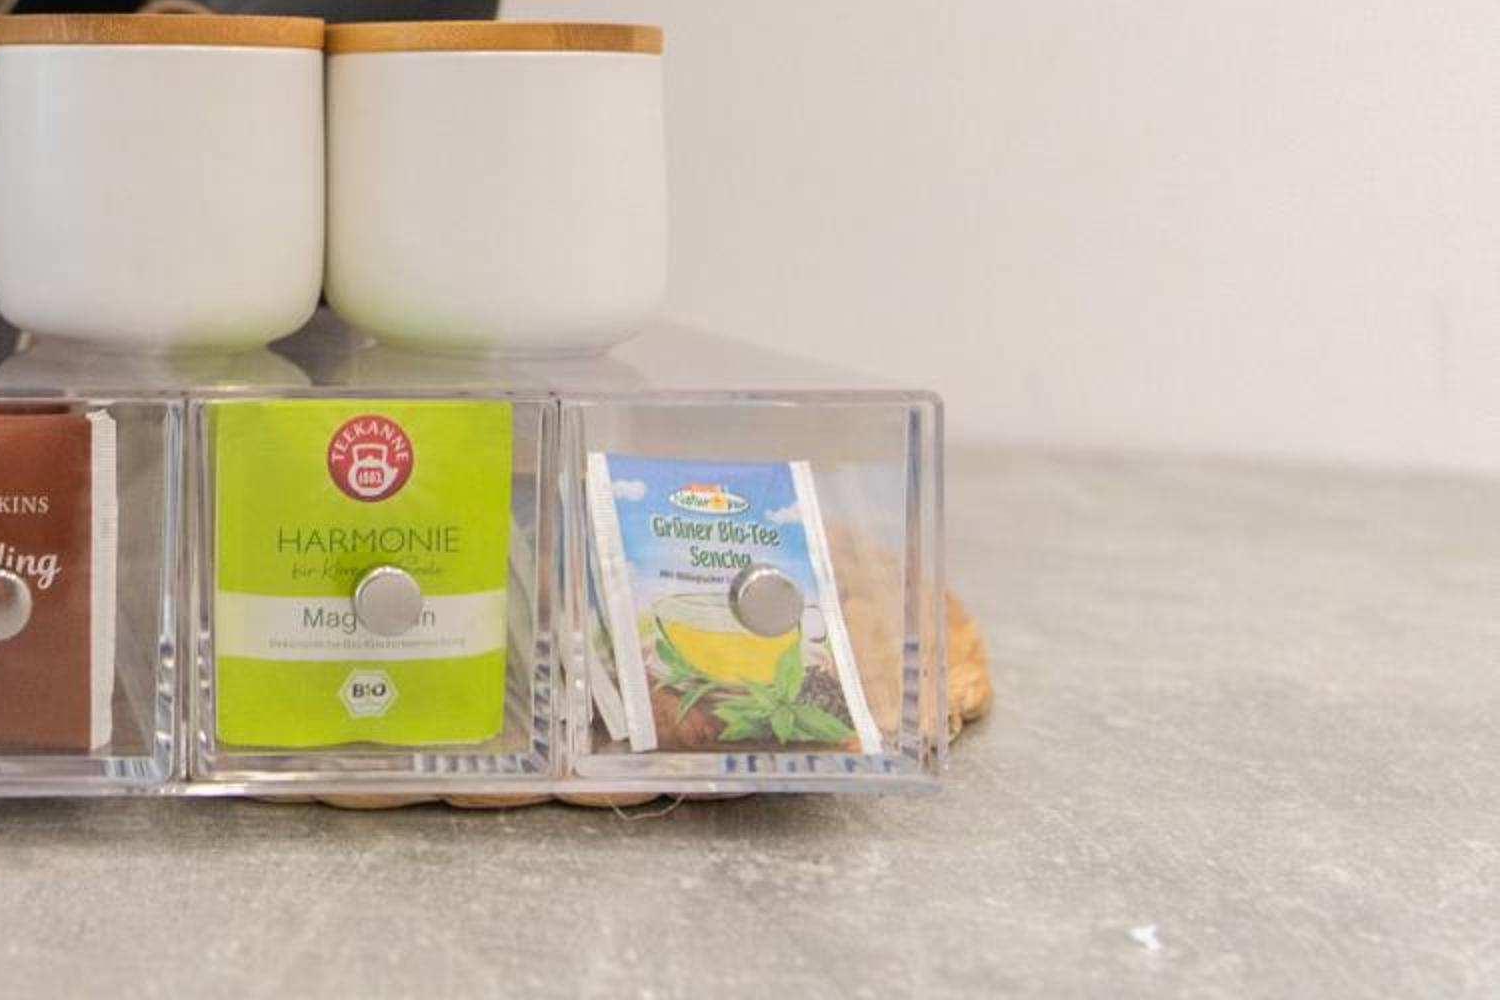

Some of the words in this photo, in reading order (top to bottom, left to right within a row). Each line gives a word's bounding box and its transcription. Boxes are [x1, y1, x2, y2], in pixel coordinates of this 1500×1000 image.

[331, 420, 409, 464] TEEKANNE
[277, 526, 461, 553] HARMONIE
[652, 516, 713, 541] Grüner
[717, 519, 781, 547] Bio-Tee
[689, 545, 752, 569] Sencha
